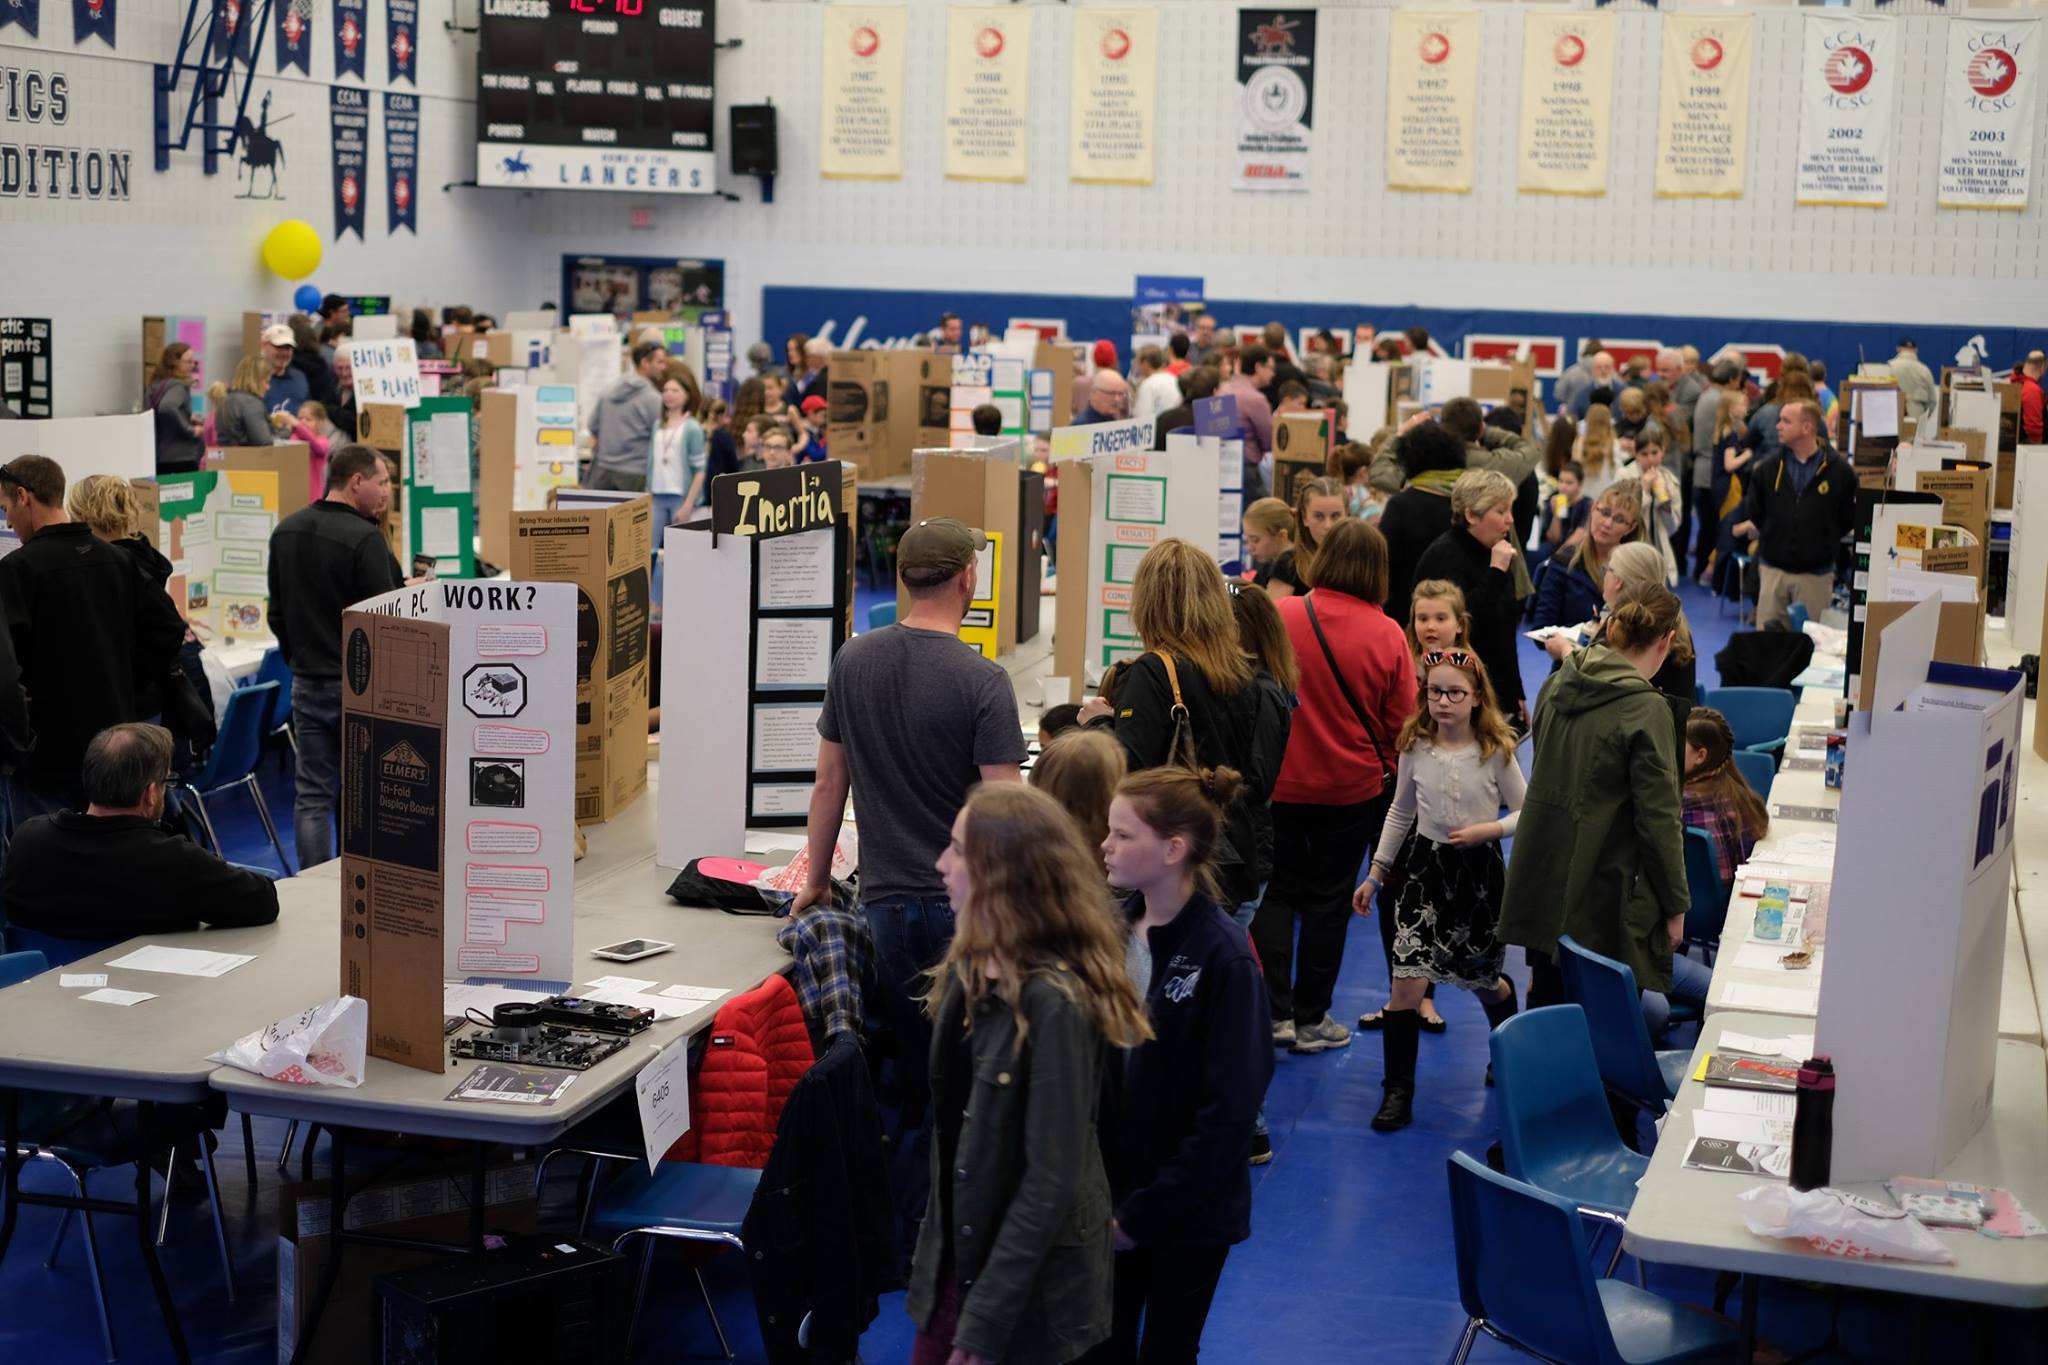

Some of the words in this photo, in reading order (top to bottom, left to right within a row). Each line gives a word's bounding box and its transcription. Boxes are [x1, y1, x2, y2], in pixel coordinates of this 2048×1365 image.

[659, 8, 703, 27] GUEST
[1824, 31, 1875, 52] CCAA
[0, 66, 68, 125] ICS
[1828, 128, 1864, 140] 2002
[1969, 130, 2005, 142] 2003
[560, 164, 702, 188] LANCERS
[1944, 167, 1974, 176] SILVER
[2, 337, 41, 357] prints
[353, 346, 392, 368] EATING
[382, 376, 419, 398] PLANET
[734, 471, 834, 536] Inertia
[519, 516, 537, 525] Bring
[538, 516, 553, 524] Your
[553, 515, 571, 523] Ideas
[1120, 528, 1152, 539] RESULTS
[444, 585, 537, 611] WORK?
[383, 763, 426, 780] ELMER'S
[380, 781, 411, 797] Tri-Fold
[380, 795, 408, 813] Display
[410, 801, 435, 816] Board
